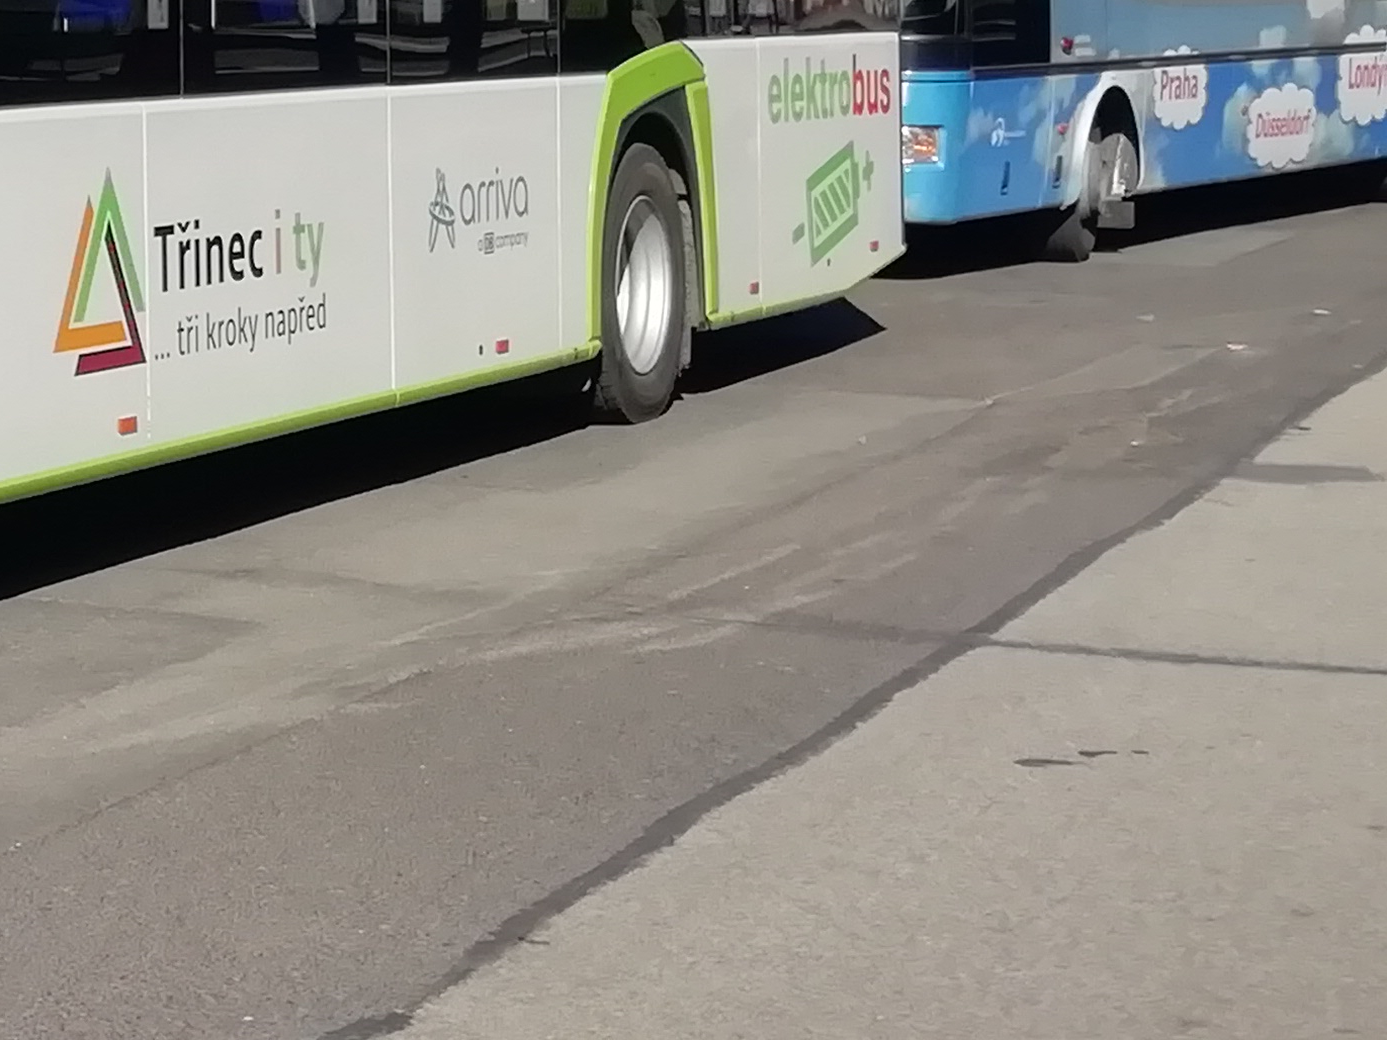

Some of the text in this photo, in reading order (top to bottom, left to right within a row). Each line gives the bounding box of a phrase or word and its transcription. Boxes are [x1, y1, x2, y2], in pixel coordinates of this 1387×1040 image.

[768, 53, 891, 125] elektrobus
[1160, 69, 1199, 101] Praha
[1255, 108, 1313, 140] Düsseldorf
[459, 166, 529, 226] arriva
[153, 208, 325, 293] Třinec i ty
[177, 314, 200, 356] tři
[206, 307, 259, 353] kroky
[264, 292, 327, 345] napřed
